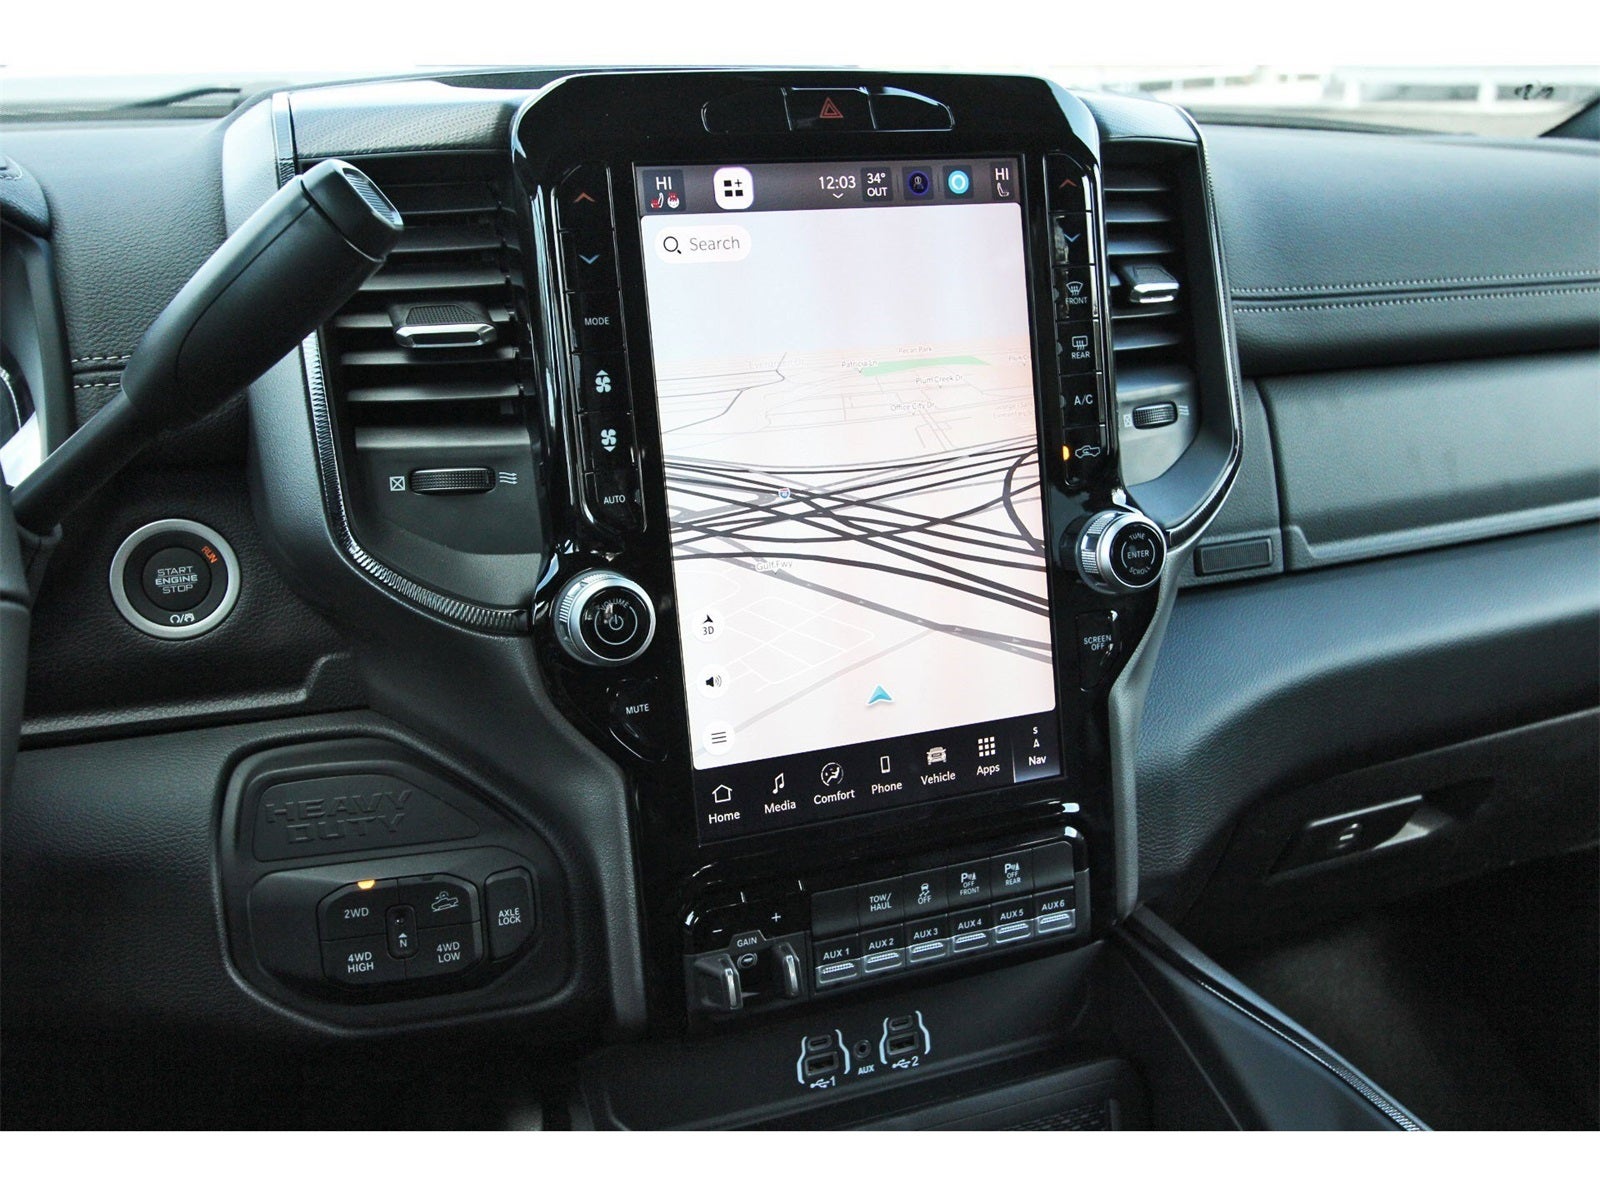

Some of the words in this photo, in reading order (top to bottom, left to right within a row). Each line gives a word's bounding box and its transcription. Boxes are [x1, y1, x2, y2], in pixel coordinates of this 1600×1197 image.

[995, 167, 1009, 181] HI
[656, 176, 673, 190] HI
[818, 175, 857, 190] 12:03
[867, 185, 888, 198] OUT
[689, 235, 741, 252] Search
[1065, 297, 1088, 305] FRONT
[584, 316, 610, 326] MODE
[1071, 351, 1091, 360] REAR
[915, 377, 933, 385] Plum
[1073, 394, 1094, 406] A/C
[890, 404, 911, 412] Office
[912, 402, 925, 411] City
[603, 494, 626, 505] AUTO
[1129, 532, 1146, 541] TUNE
[201, 545, 218, 564] RUN
[1127, 549, 1150, 560] ENTER
[157, 565, 194, 576] START
[757, 560, 775, 571] Gulf
[155, 574, 198, 586] ENGINE
[162, 584, 194, 595] STOP
[703, 626, 715, 635] 3D
[1083, 634, 1112, 645] SCREEN
[1091, 642, 1105, 651] OFF
[625, 703, 650, 715] MUTE
[1028, 755, 1047, 766] Nav
[976, 763, 1000, 777] Apps
[920, 770, 956, 785] Vehicle
[871, 781, 903, 795] Phone
[813, 789, 856, 805] Comfort
[265, 789, 413, 824] HEAVY
[764, 800, 797, 815] Media
[708, 810, 741, 824] Home
[286, 813, 406, 844] DUTY
[1006, 870, 1020, 879] OFF
[962, 880, 975, 888] OFF
[1005, 877, 1022, 887] REAR
[959, 886, 980, 896] FRONT
[869, 892, 892, 904] TOW/
[917, 896, 932, 905] OFF
[344, 907, 369, 919] 2WD
[498, 907, 520, 918] AXLE
[870, 902, 892, 912] HAUL
[1041, 902, 1059, 912] AUX
[498, 914, 522, 926] LOCK
[1000, 910, 1018, 921] AUX
[957, 920, 976, 931] AUX
[976, 918, 982, 927] 4
[913, 929, 932, 940] AUX
[932, 927, 939, 936] 3
[399, 939, 408, 948] N
[437, 941, 460, 953] 4WD
[736, 936, 758, 948] GAIN
[868, 939, 888, 951] AUX
[888, 937, 894, 947] 2
[348, 951, 373, 963] 4WD
[438, 952, 461, 964] LOW
[823, 949, 843, 961] AUX
[844, 947, 850, 956] 1
[347, 962, 375, 974] HIGH
[857, 1064, 875, 1076] AUX
